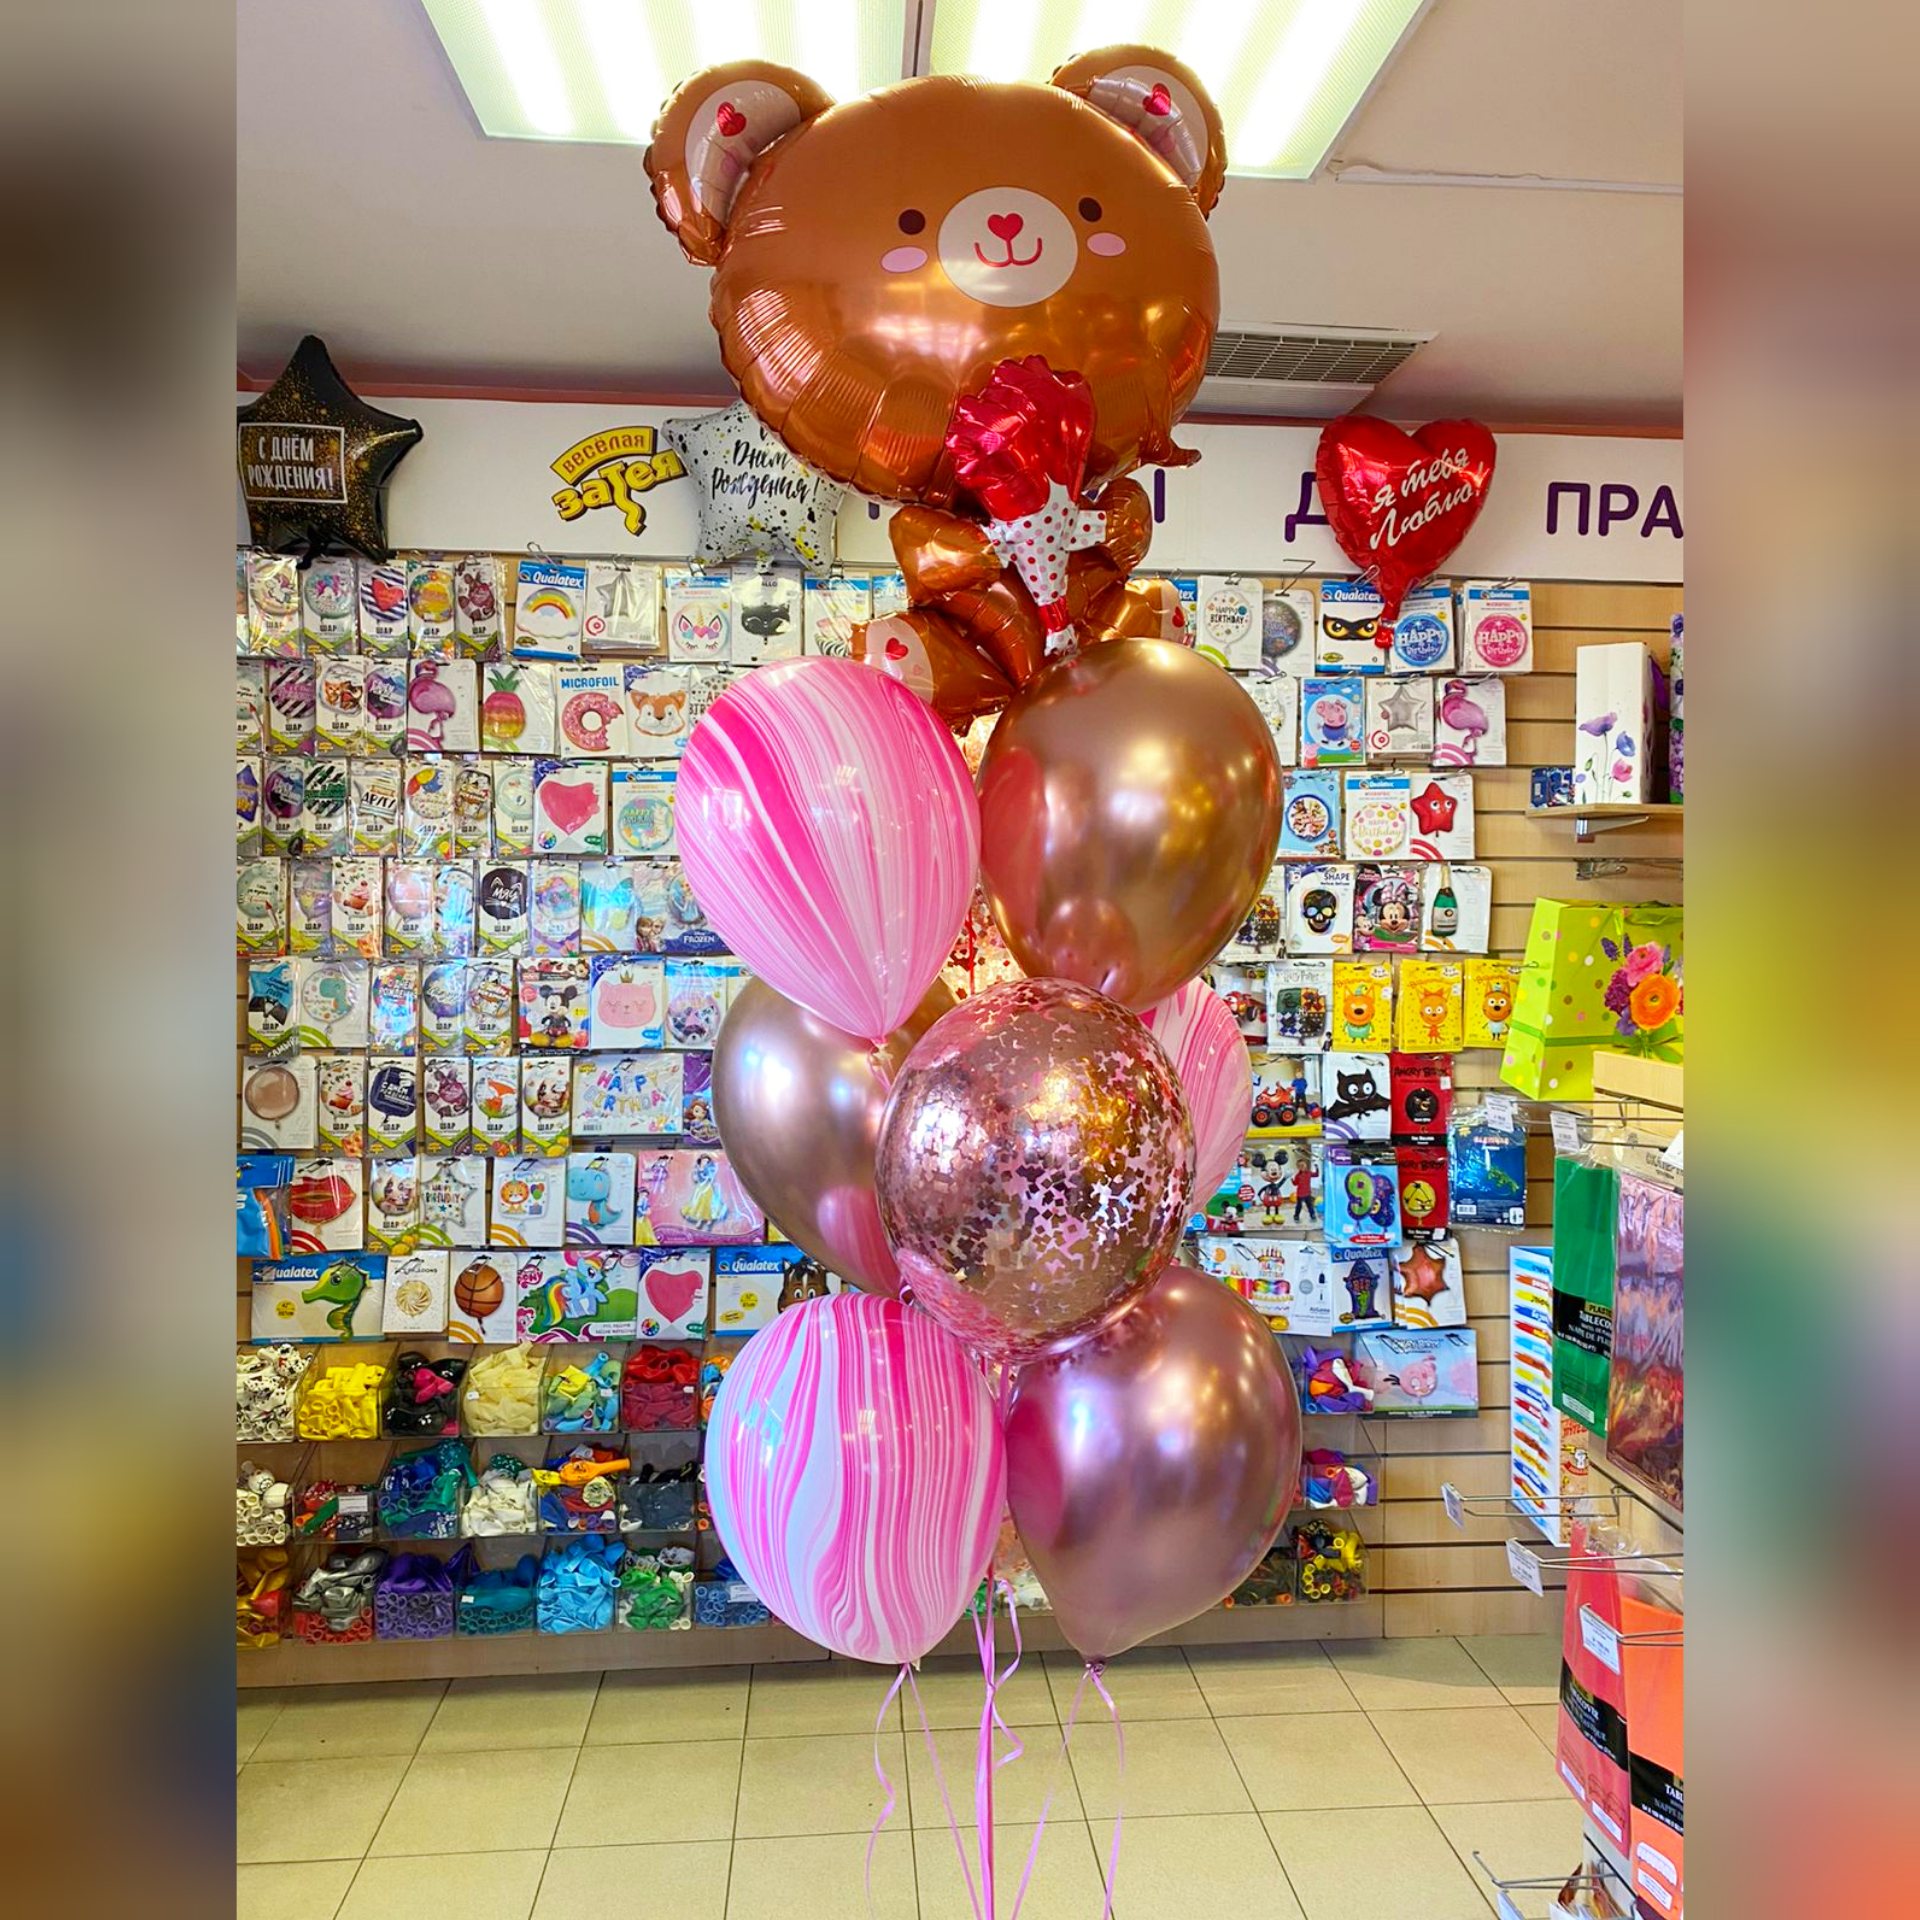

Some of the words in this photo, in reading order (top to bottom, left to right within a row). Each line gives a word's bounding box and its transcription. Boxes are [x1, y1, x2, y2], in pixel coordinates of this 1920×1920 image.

[258, 437, 266, 459] С
[270, 433, 315, 463] ДНЁМ
[247, 464, 334, 492] РОЖДЕНИЯ!
[533, 571, 583, 587] Qualatex
[1210, 614, 1244, 625] BIRTHDAY
[376, 626, 393, 635] ШАР
[561, 676, 620, 690] MICROFOIL
[285, 723, 302, 731] ШАР
[332, 722, 349, 730] ШАР
[375, 723, 392, 731] ШАР
[275, 823, 291, 831] ШАР
[314, 823, 332, 831] ШАР
[366, 824, 384, 832] ШАР
[1324, 873, 1350, 881] SHAPE
[246, 923, 264, 931] ШАР
[305, 923, 322, 931] ШАР
[347, 923, 365, 931] ШАР
[683, 935, 715, 944] FROZEN
[262, 1023, 279, 1031] ШАР
[597, 1069, 659, 1093] HAPPY
[332, 1123, 349, 1131] ШАР
[439, 1122, 455, 1130] ШАР
[487, 1123, 504, 1131] ШАР
[537, 1123, 554, 1131] ШАР
[383, 1220, 398, 1229] ШАР
[731, 1259, 780, 1272] Qualatex
[275, 1266, 320, 1279] ualatex
